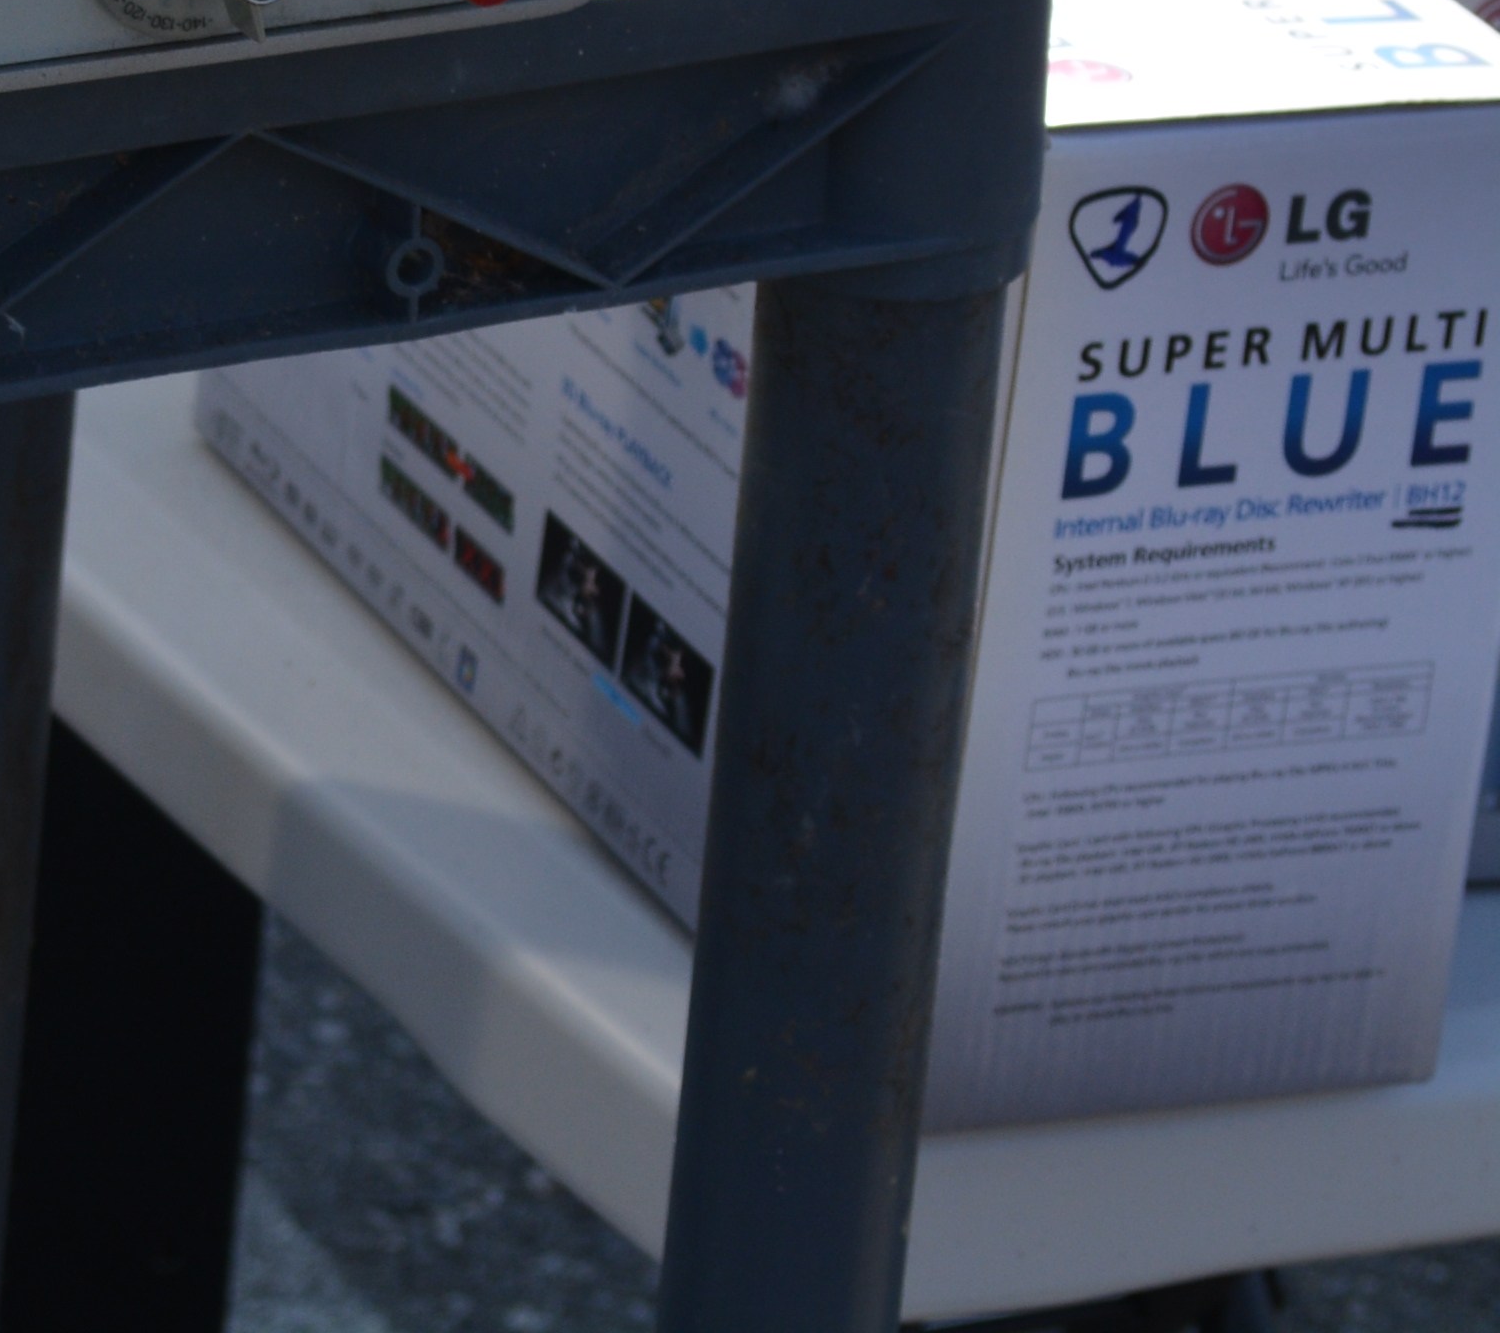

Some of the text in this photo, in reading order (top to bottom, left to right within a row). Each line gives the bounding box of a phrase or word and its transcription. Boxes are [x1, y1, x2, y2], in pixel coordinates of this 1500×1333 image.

[1285, 187, 1372, 245] LG
[1279, 251, 1408, 282] Life's Good
[1077, 307, 1489, 382] SUPER MULTI
[1060, 359, 1483, 500] BLUE
[1053, 508, 1144, 540] Internal
[1148, 499, 1229, 532] Blu-ray
[1235, 495, 1281, 522] Disc
[1286, 488, 1386, 517] Rewriter
